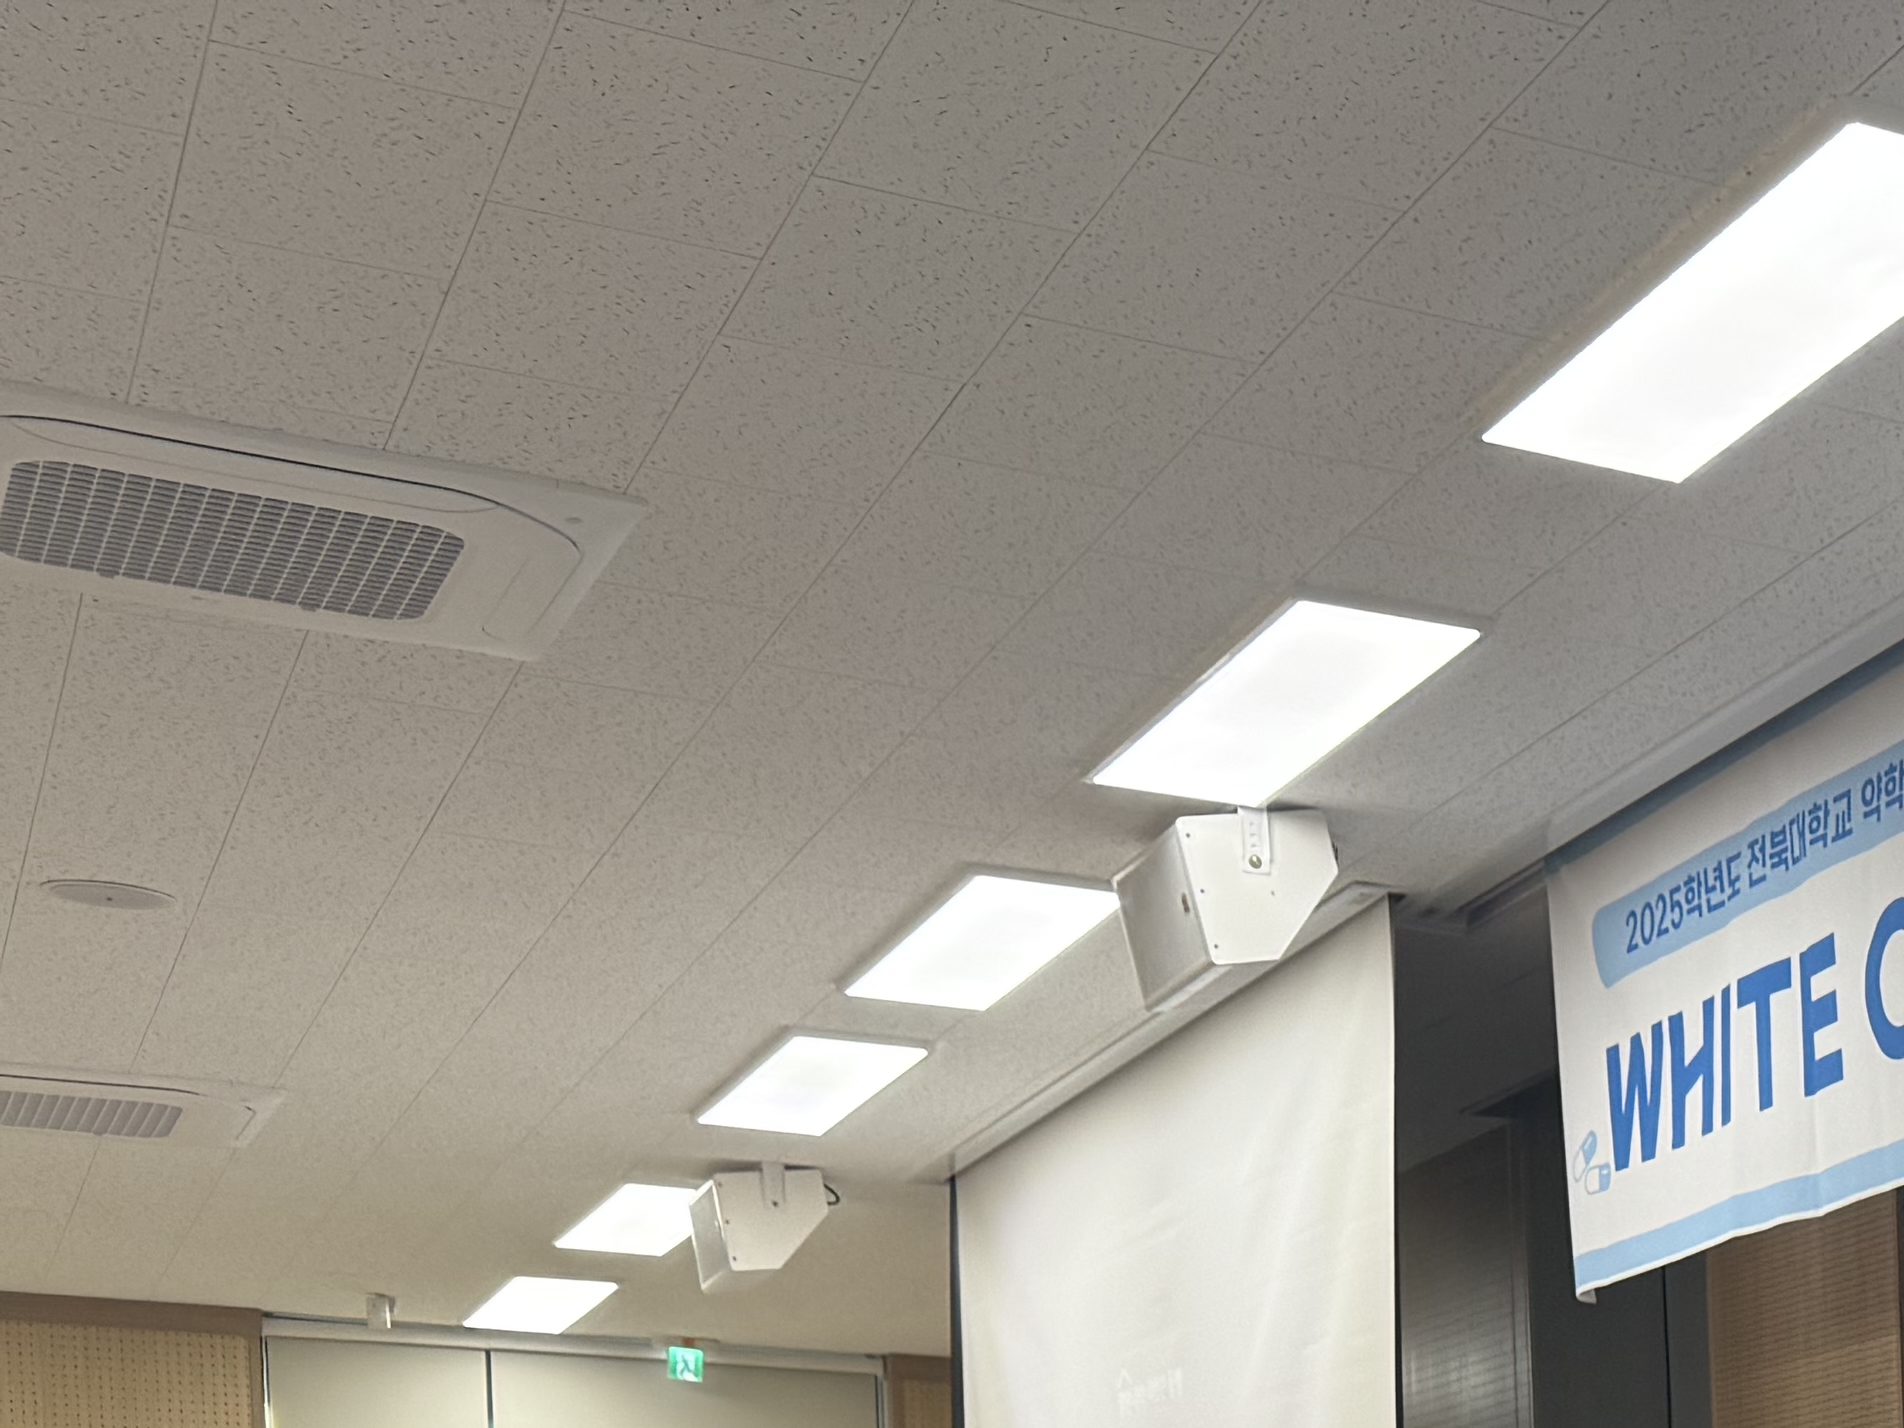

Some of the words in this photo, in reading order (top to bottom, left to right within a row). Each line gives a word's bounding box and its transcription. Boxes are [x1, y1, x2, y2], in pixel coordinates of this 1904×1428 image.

[1625, 850, 1742, 955] 2025학년도
[1746, 788, 1855, 889] 전북대학교
[1604, 931, 1845, 1172] WHITE
